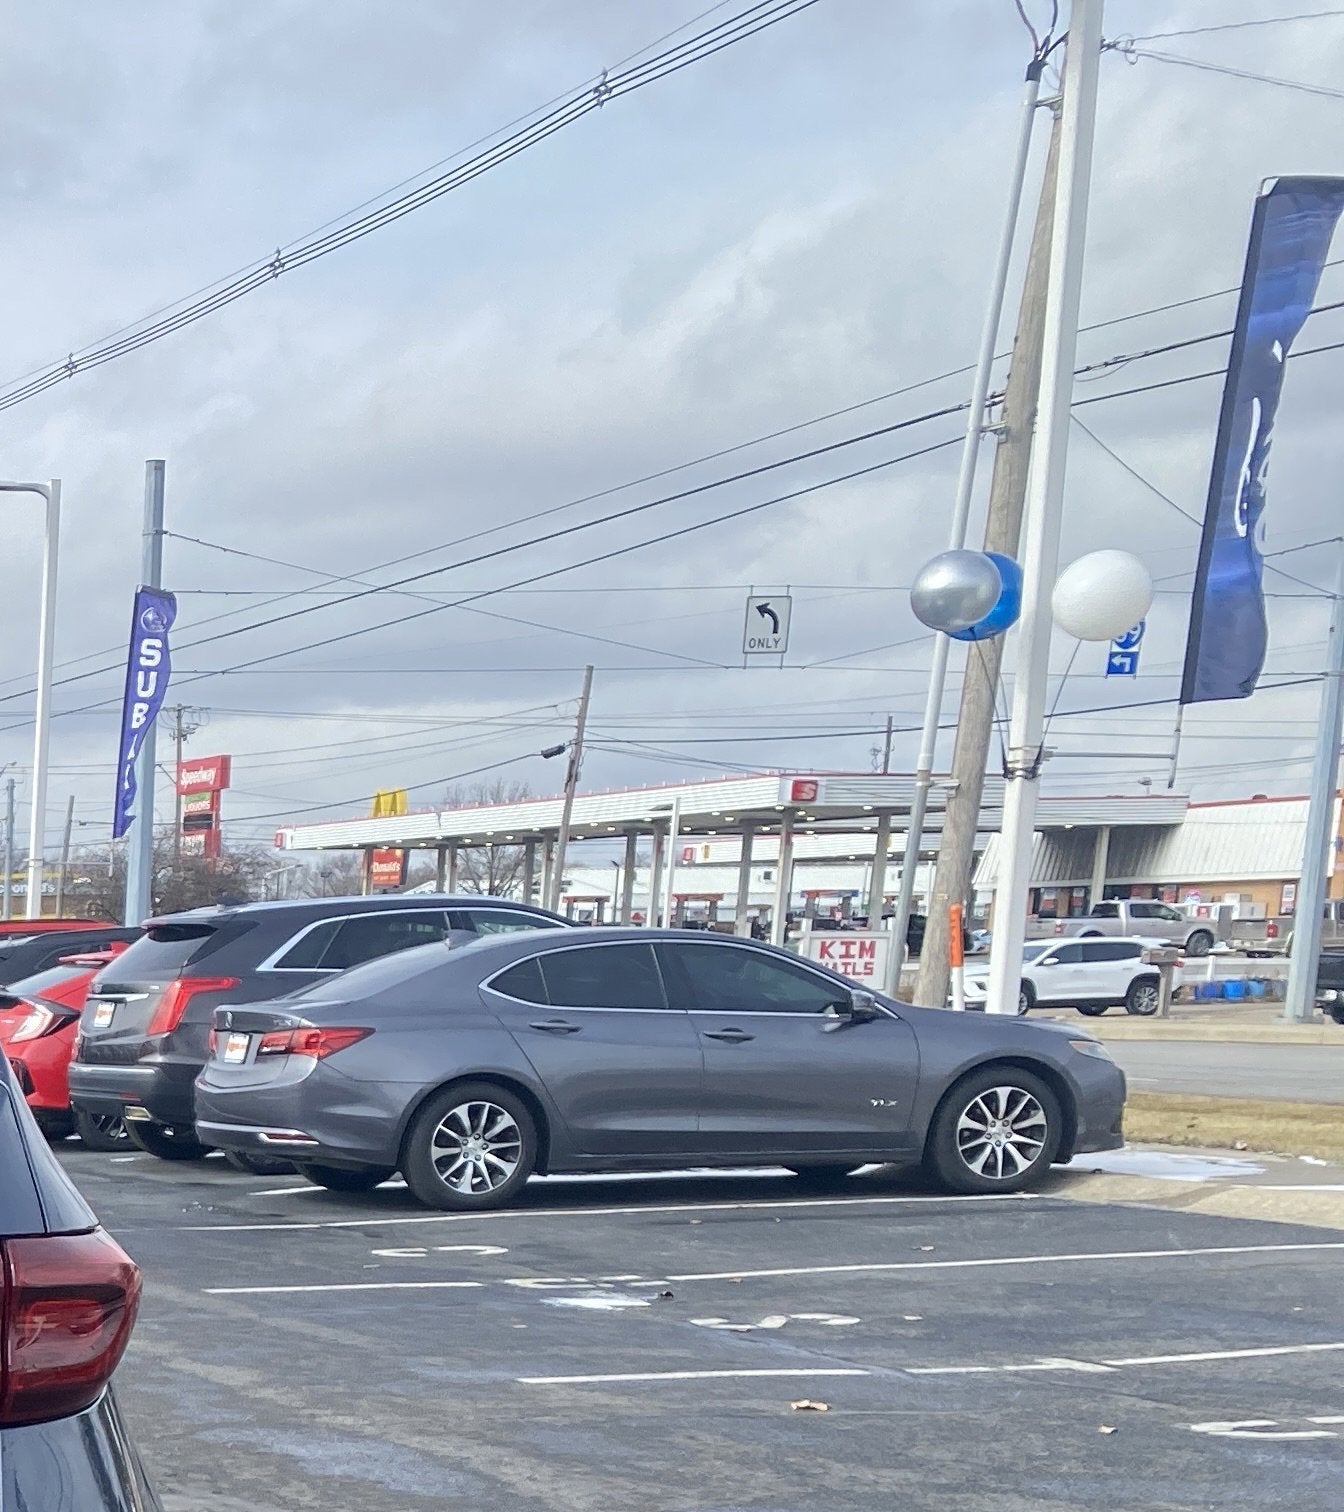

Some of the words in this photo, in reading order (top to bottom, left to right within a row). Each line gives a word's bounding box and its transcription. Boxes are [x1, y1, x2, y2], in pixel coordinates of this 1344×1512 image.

[748, 637, 782, 649] ONLY
[819, 940, 877, 960] KIM
[820, 961, 875, 976] AILS
